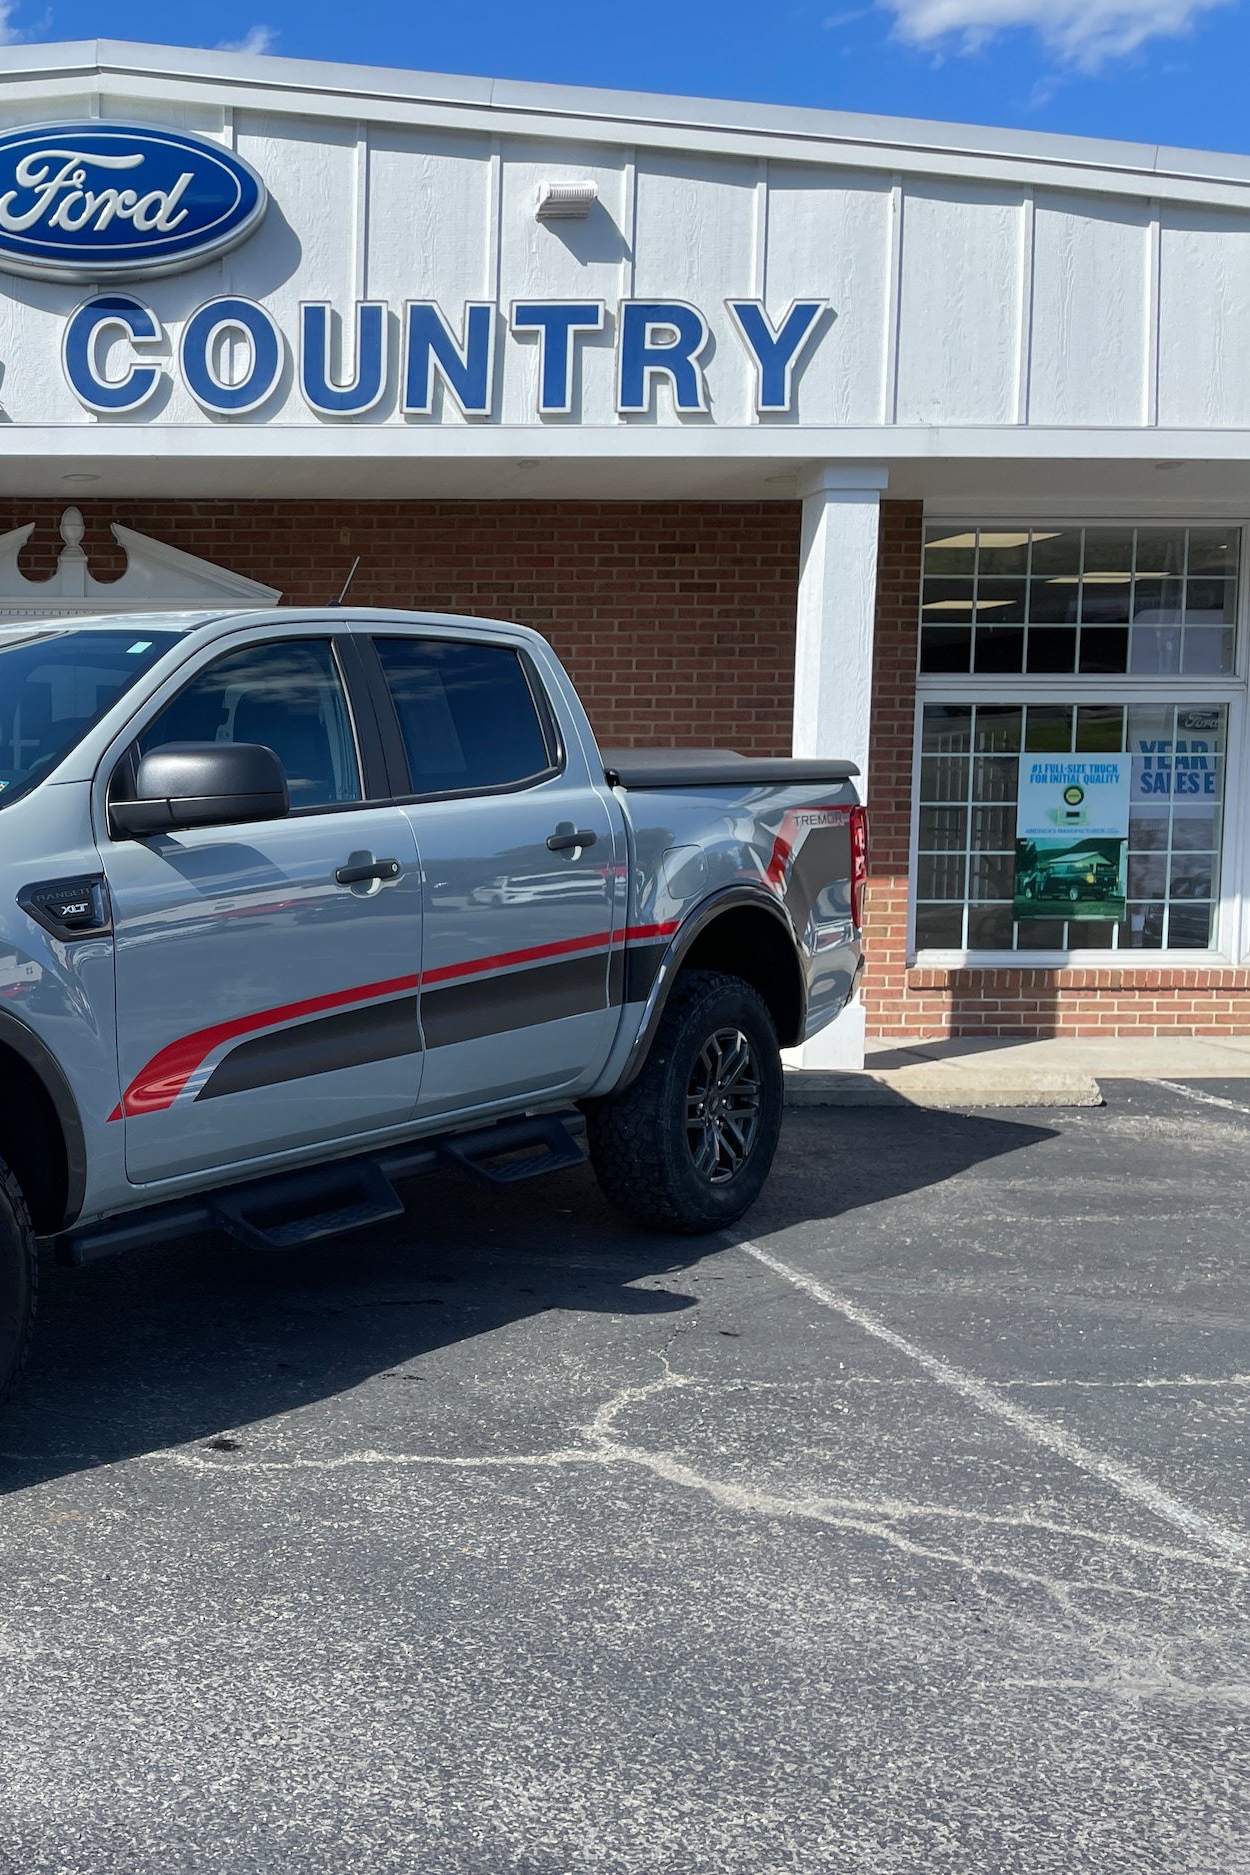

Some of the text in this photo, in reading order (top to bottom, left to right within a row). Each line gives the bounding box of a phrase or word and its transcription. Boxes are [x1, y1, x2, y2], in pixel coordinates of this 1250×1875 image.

[61, 291, 830, 416] COUNTRY
[1139, 741, 1209, 770] YEAR
[1045, 764, 1087, 774] FULL-SIZE
[1089, 764, 1118, 774] TRUCK
[1030, 774, 1120, 785] FOR INITIAL QUALITY
[1140, 771, 1200, 794] SALES
[793, 813, 843, 827] TREMOR
[36, 887, 90, 902] RANGER
[60, 902, 89, 915] XLT
